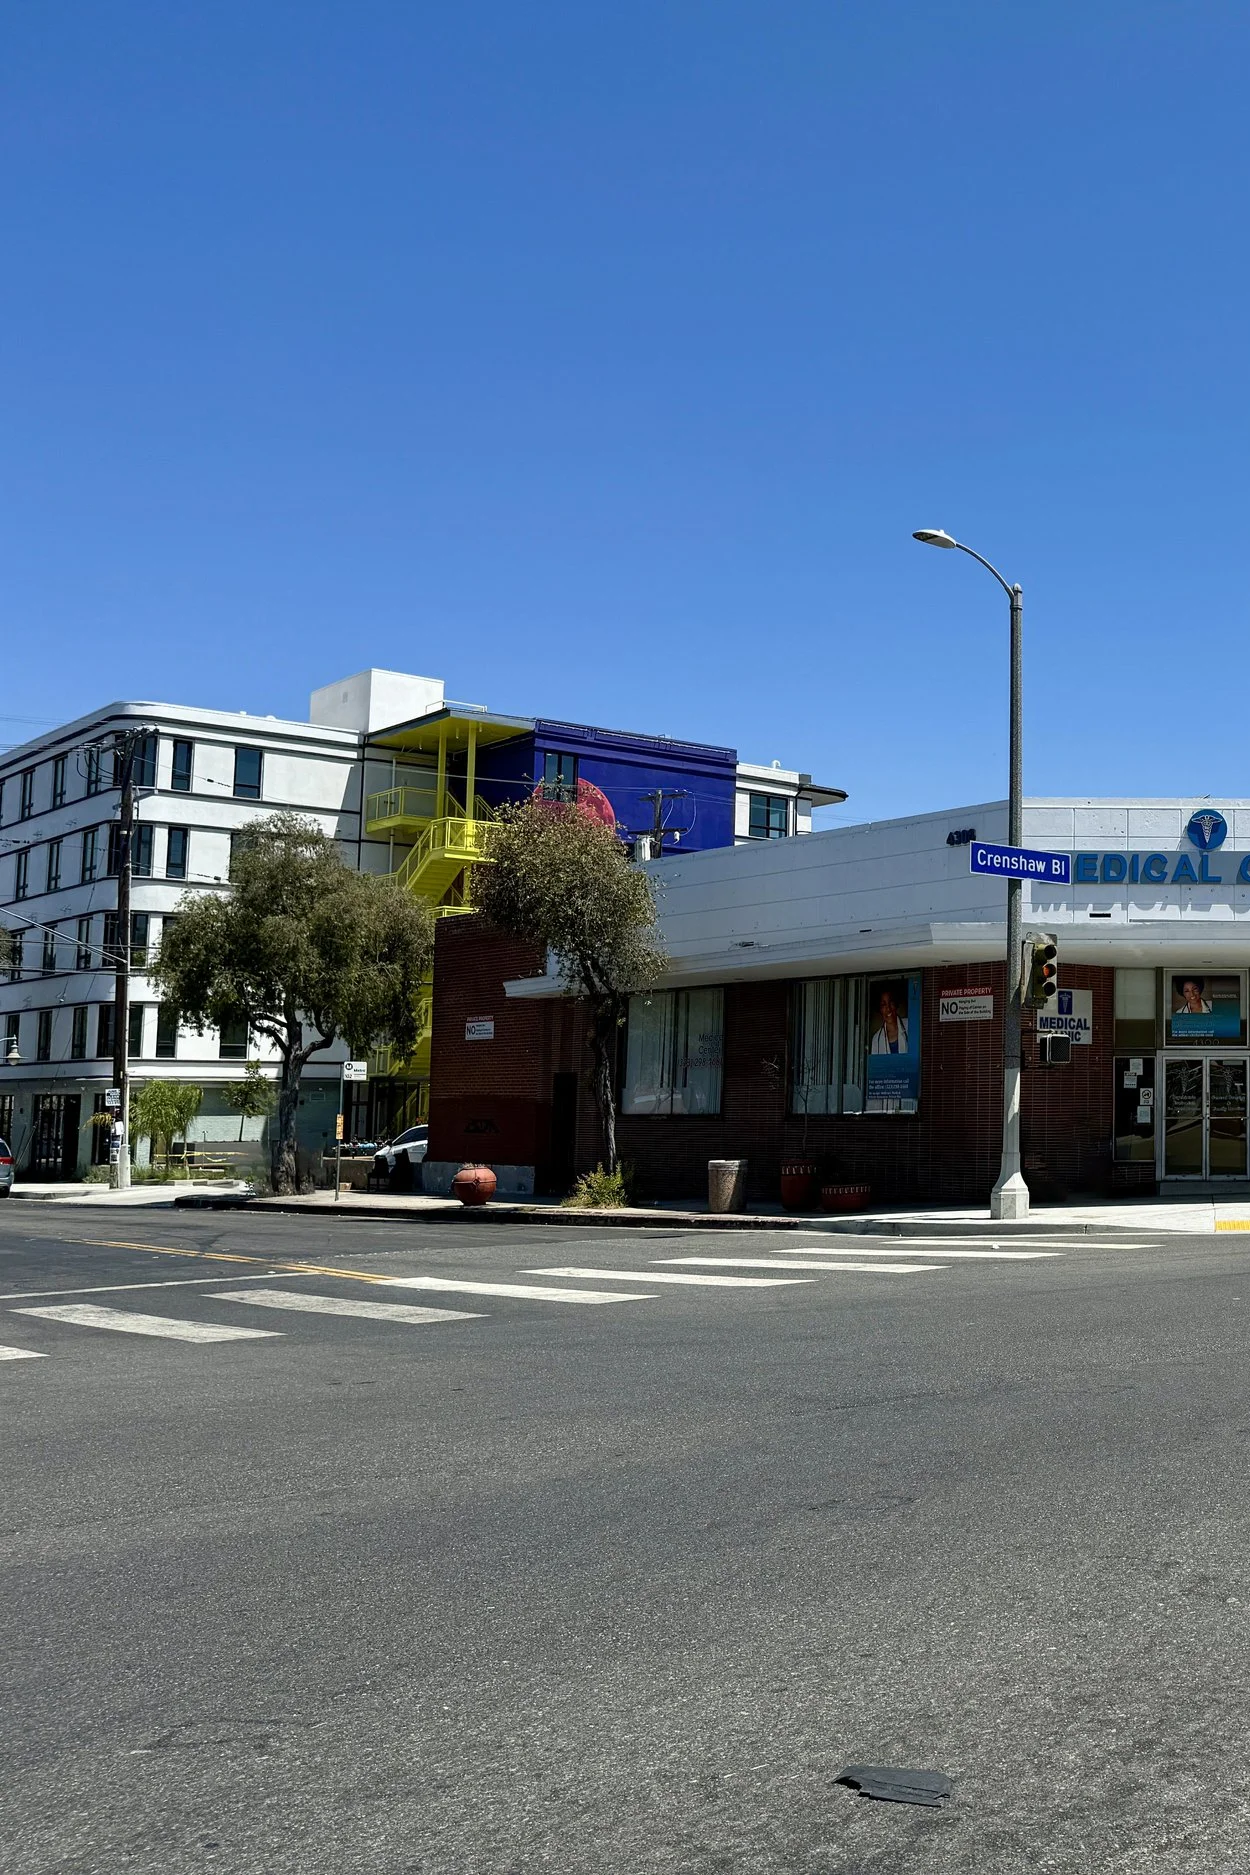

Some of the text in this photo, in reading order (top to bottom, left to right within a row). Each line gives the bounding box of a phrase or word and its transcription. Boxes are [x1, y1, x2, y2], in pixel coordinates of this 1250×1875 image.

[977, 849, 1065, 876] Crenshaw Bl
[1076, 853, 1222, 883] EDICAL
[941, 987, 992, 997] PRIVATE PROPERTY
[942, 1001, 958, 1015] NO
[467, 1025, 476, 1035] NO
[1039, 1017, 1091, 1031] MEDICAL
